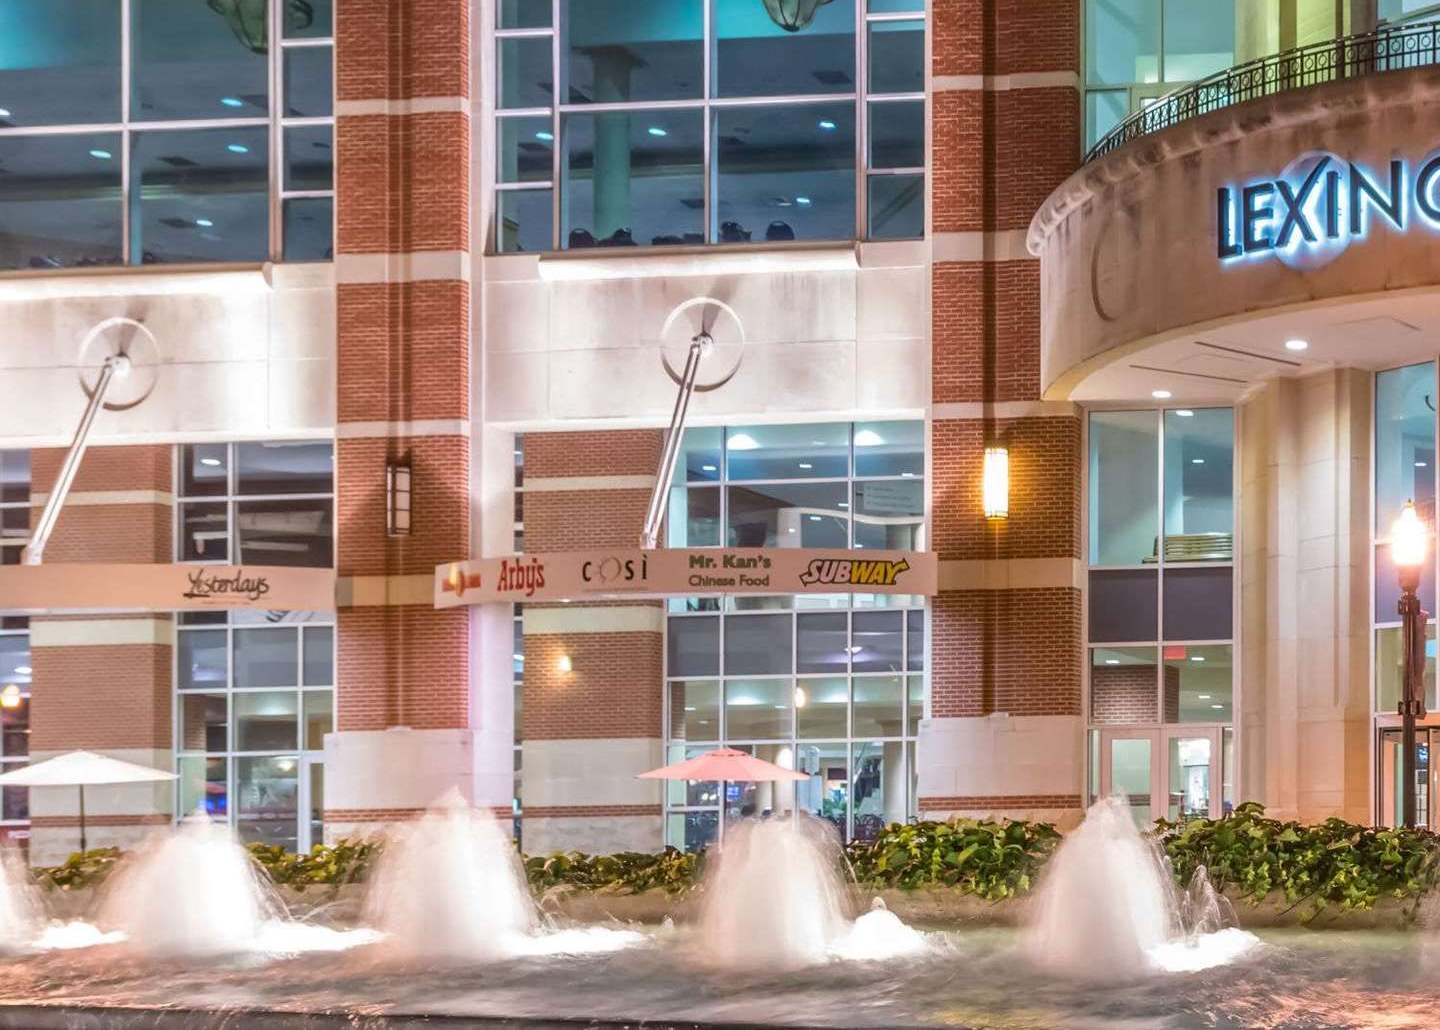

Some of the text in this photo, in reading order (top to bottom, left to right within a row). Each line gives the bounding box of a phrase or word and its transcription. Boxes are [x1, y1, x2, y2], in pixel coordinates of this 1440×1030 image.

[688, 555, 772, 569] Mr. Kan's
[800, 558, 910, 586] SUBWAY
[497, 557, 545, 597] Arby's
[688, 574, 770, 587] Chinese Food
